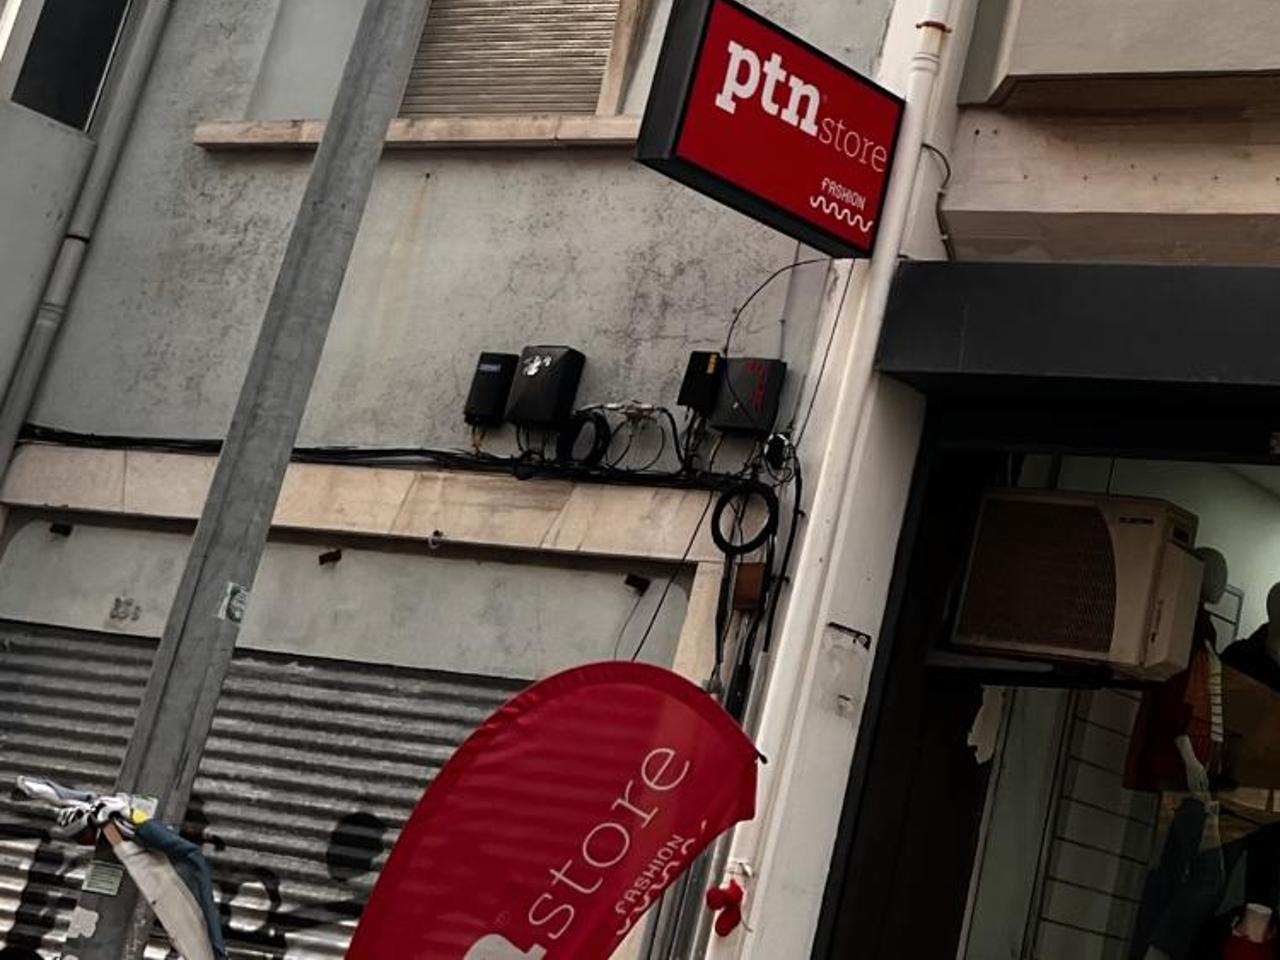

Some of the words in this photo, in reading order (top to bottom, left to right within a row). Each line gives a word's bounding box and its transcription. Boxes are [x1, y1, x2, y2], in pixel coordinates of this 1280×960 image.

[714, 40, 822, 137] ptn
[818, 117, 888, 173] store
[821, 177, 867, 210] FASHION
[527, 746, 691, 940] store
[614, 833, 685, 916] FASHION
